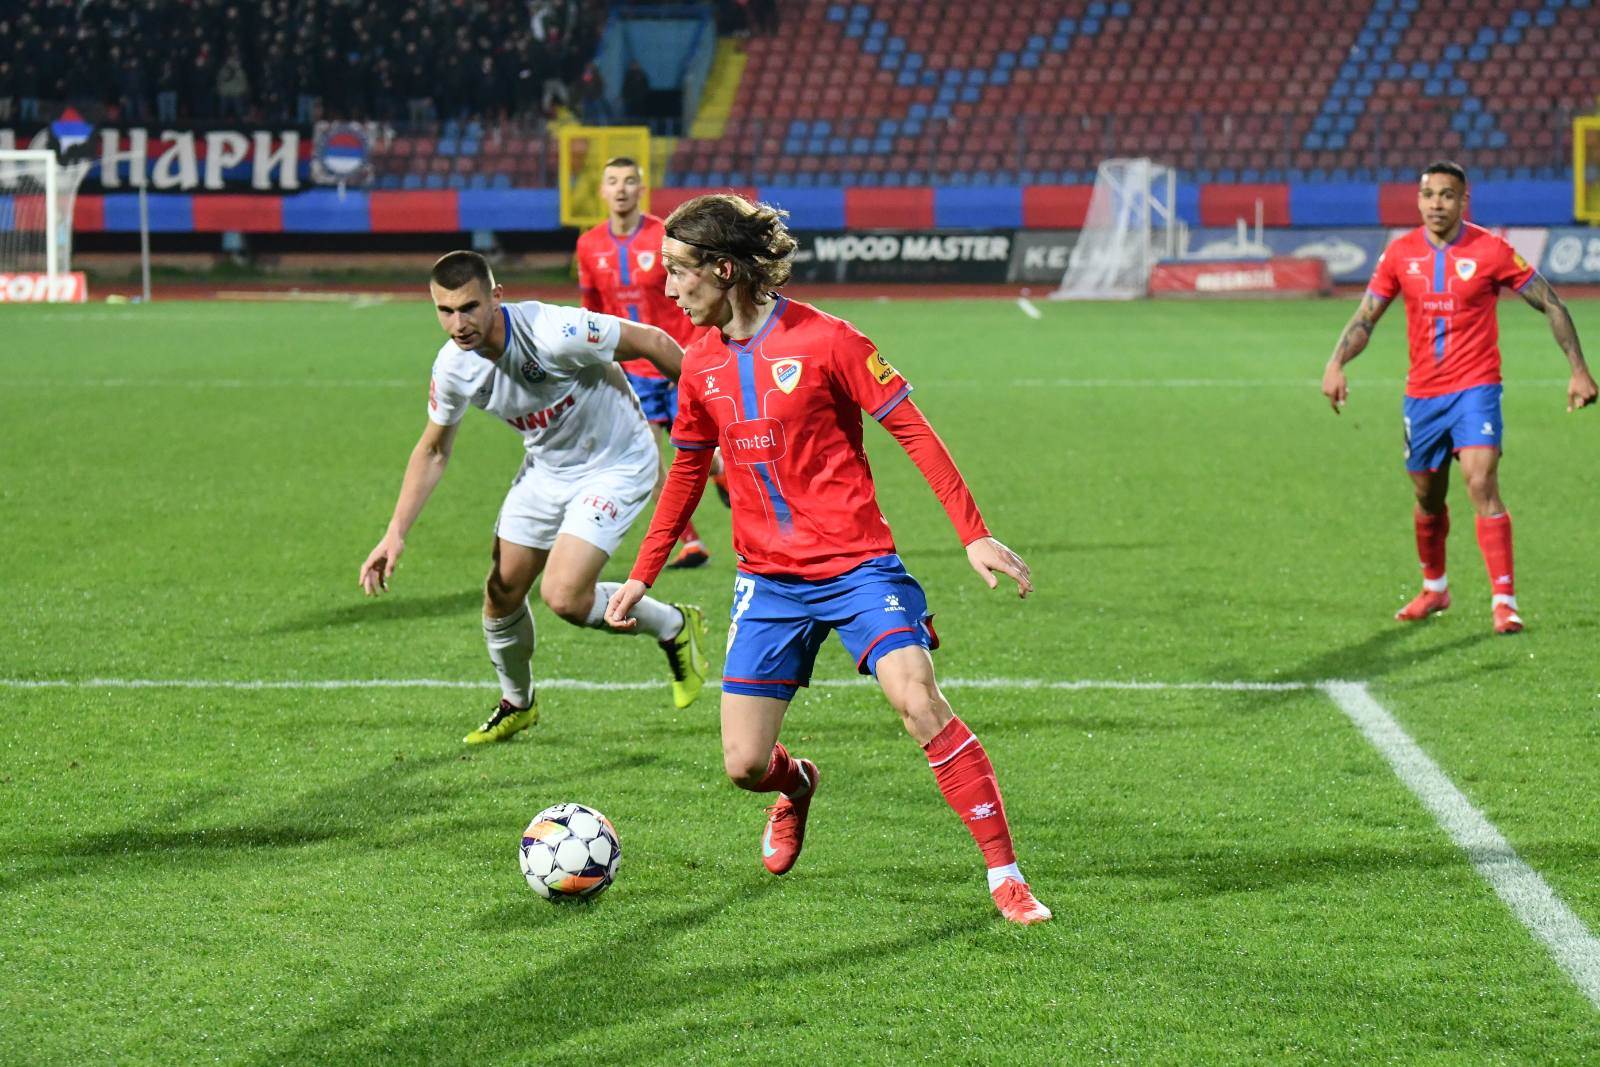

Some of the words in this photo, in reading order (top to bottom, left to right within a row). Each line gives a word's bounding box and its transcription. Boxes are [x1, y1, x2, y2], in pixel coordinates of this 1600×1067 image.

[814, 236, 899, 261] WOOD
[902, 236, 1009, 261] MASTER
[735, 428, 776, 450] m:tel
